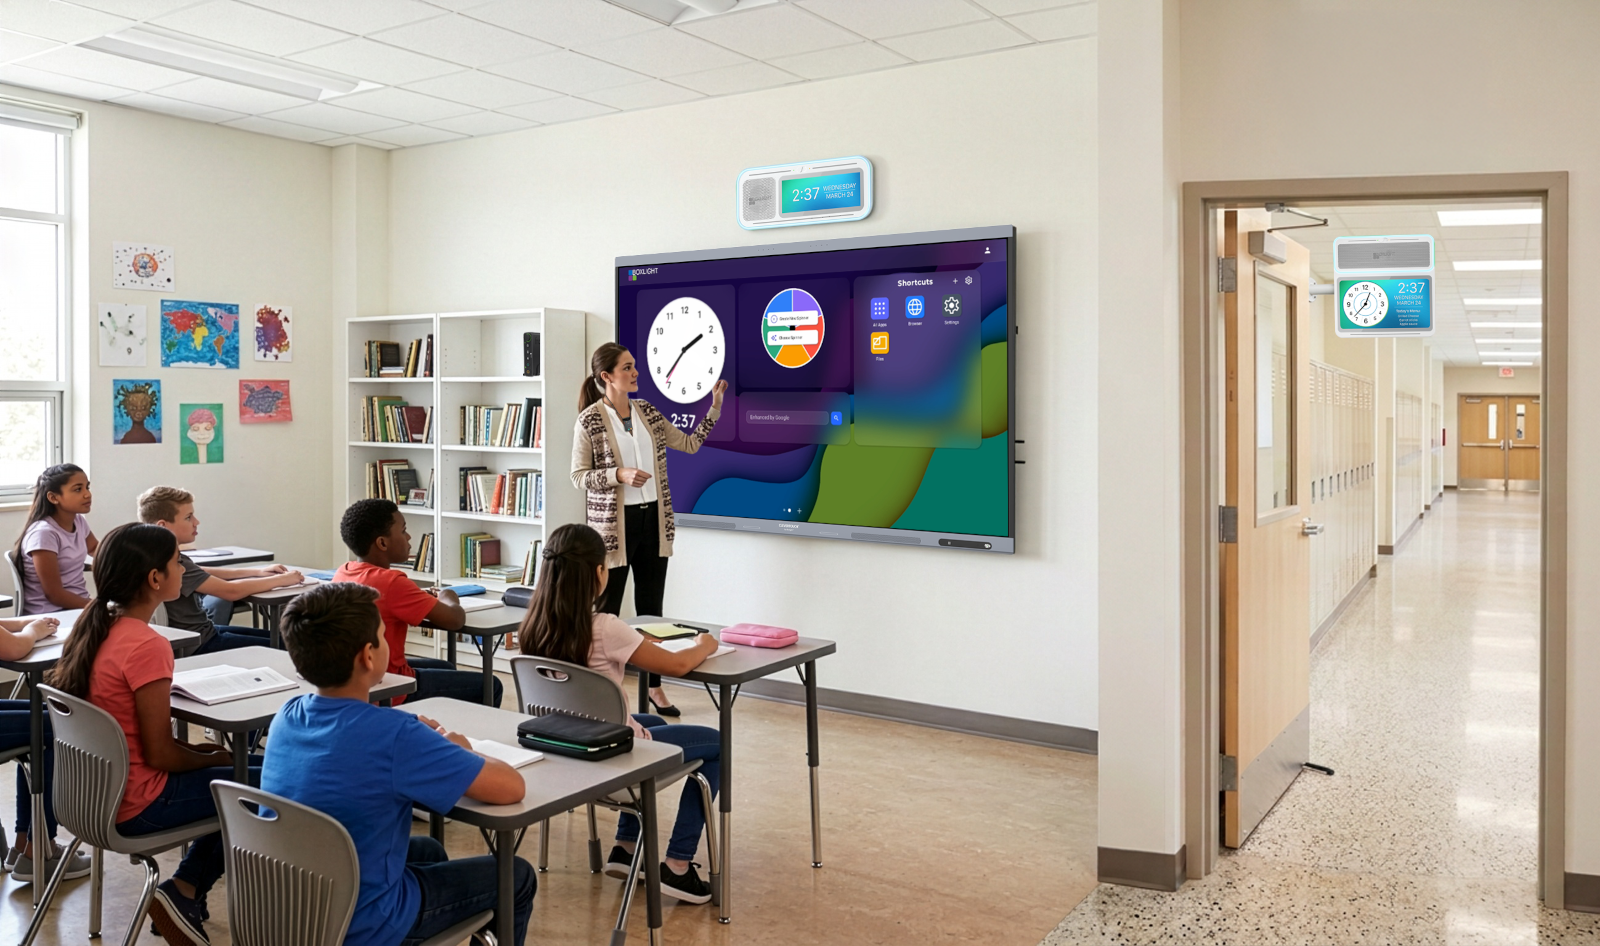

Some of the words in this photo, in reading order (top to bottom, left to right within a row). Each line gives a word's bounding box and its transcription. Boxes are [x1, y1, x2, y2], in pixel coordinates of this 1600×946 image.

[823, 183, 856, 191] WEDNESDAY
[792, 187, 820, 202] 2:37
[632, 268, 658, 276] BOXLIGHT
[898, 278, 934, 286] Shortcuts
[1398, 282, 1425, 294] 2:37
[681, 306, 689, 314] 12
[671, 413, 696, 428] 2:37
